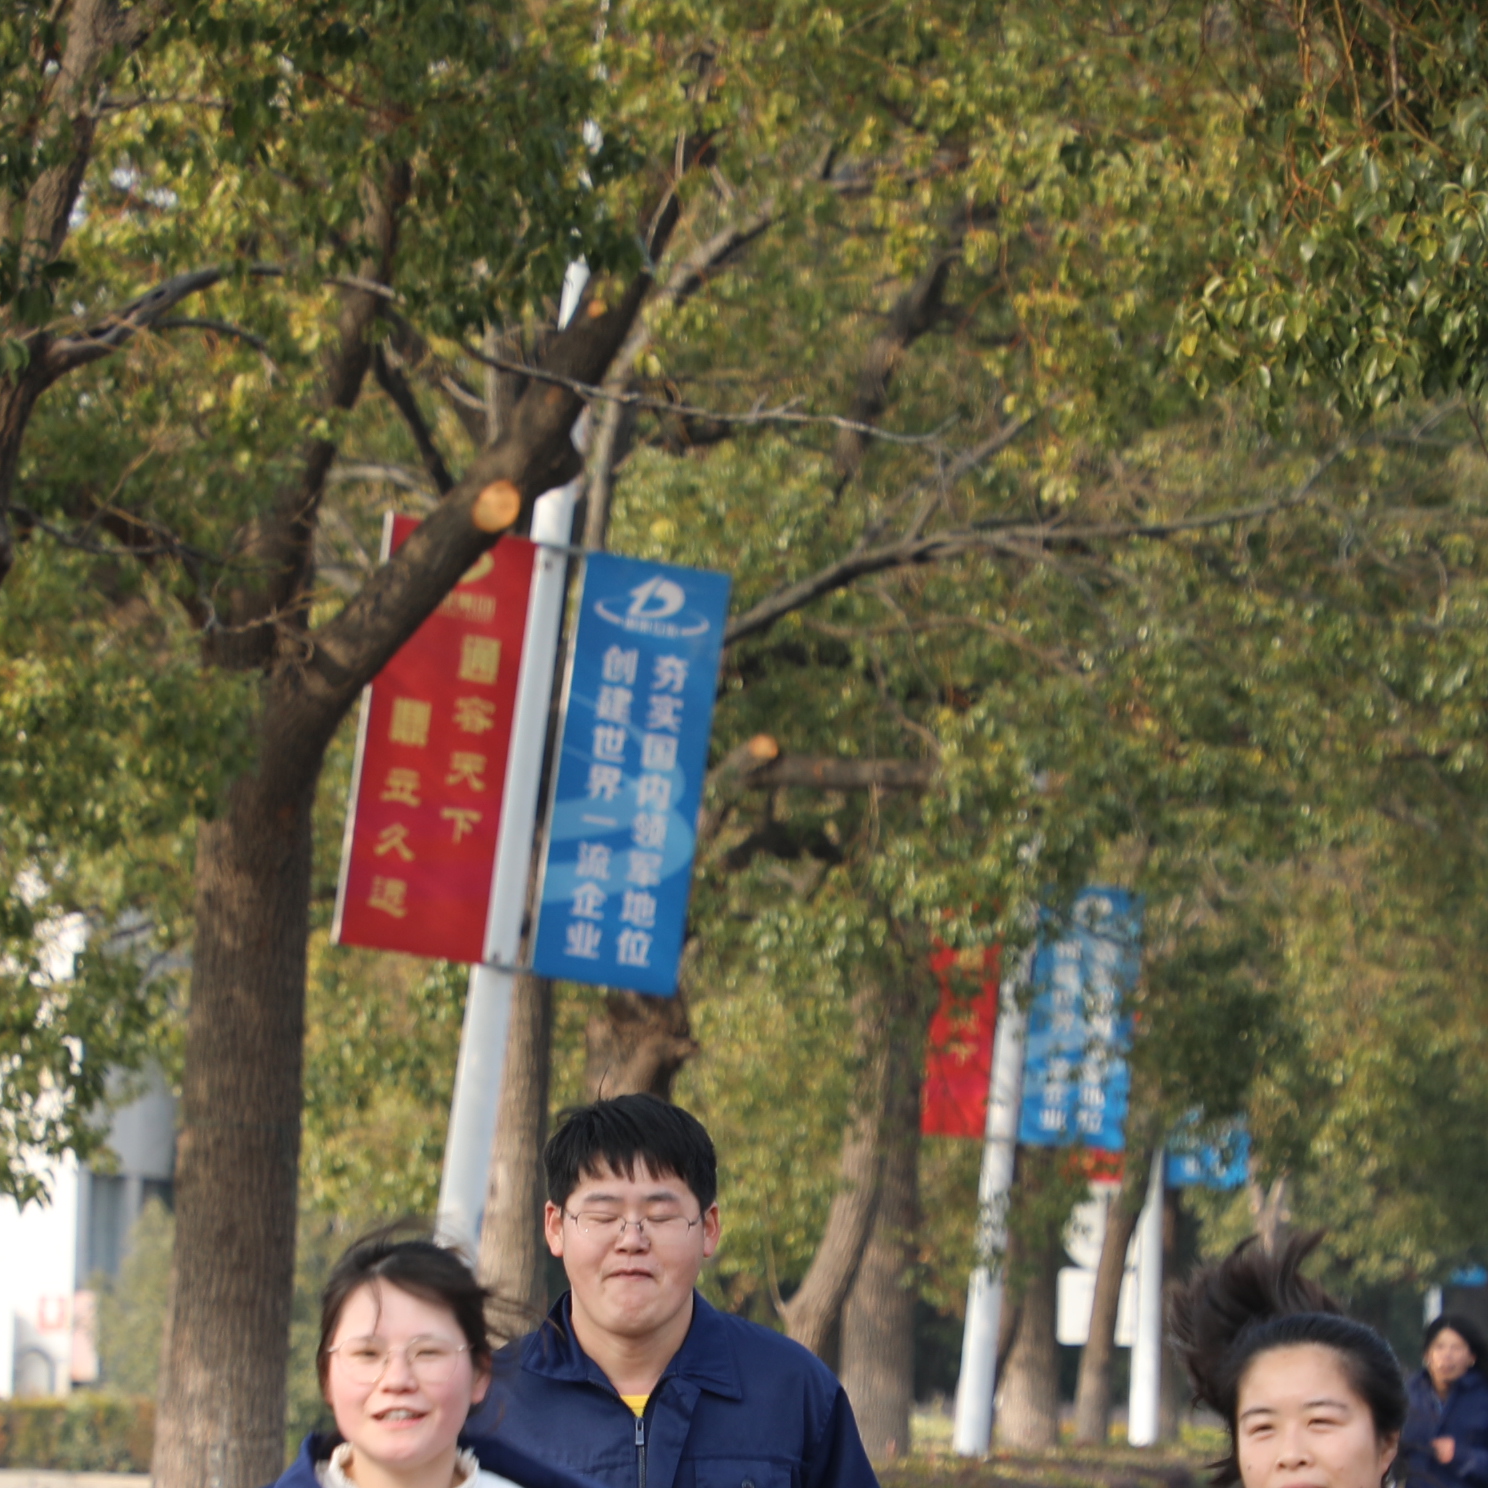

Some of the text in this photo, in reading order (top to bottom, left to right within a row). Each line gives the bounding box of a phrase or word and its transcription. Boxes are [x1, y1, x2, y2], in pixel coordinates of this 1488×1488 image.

[565, 644, 639, 960] 创建世界一流企业
[616, 653, 689, 968] 夯实国内领军地位
